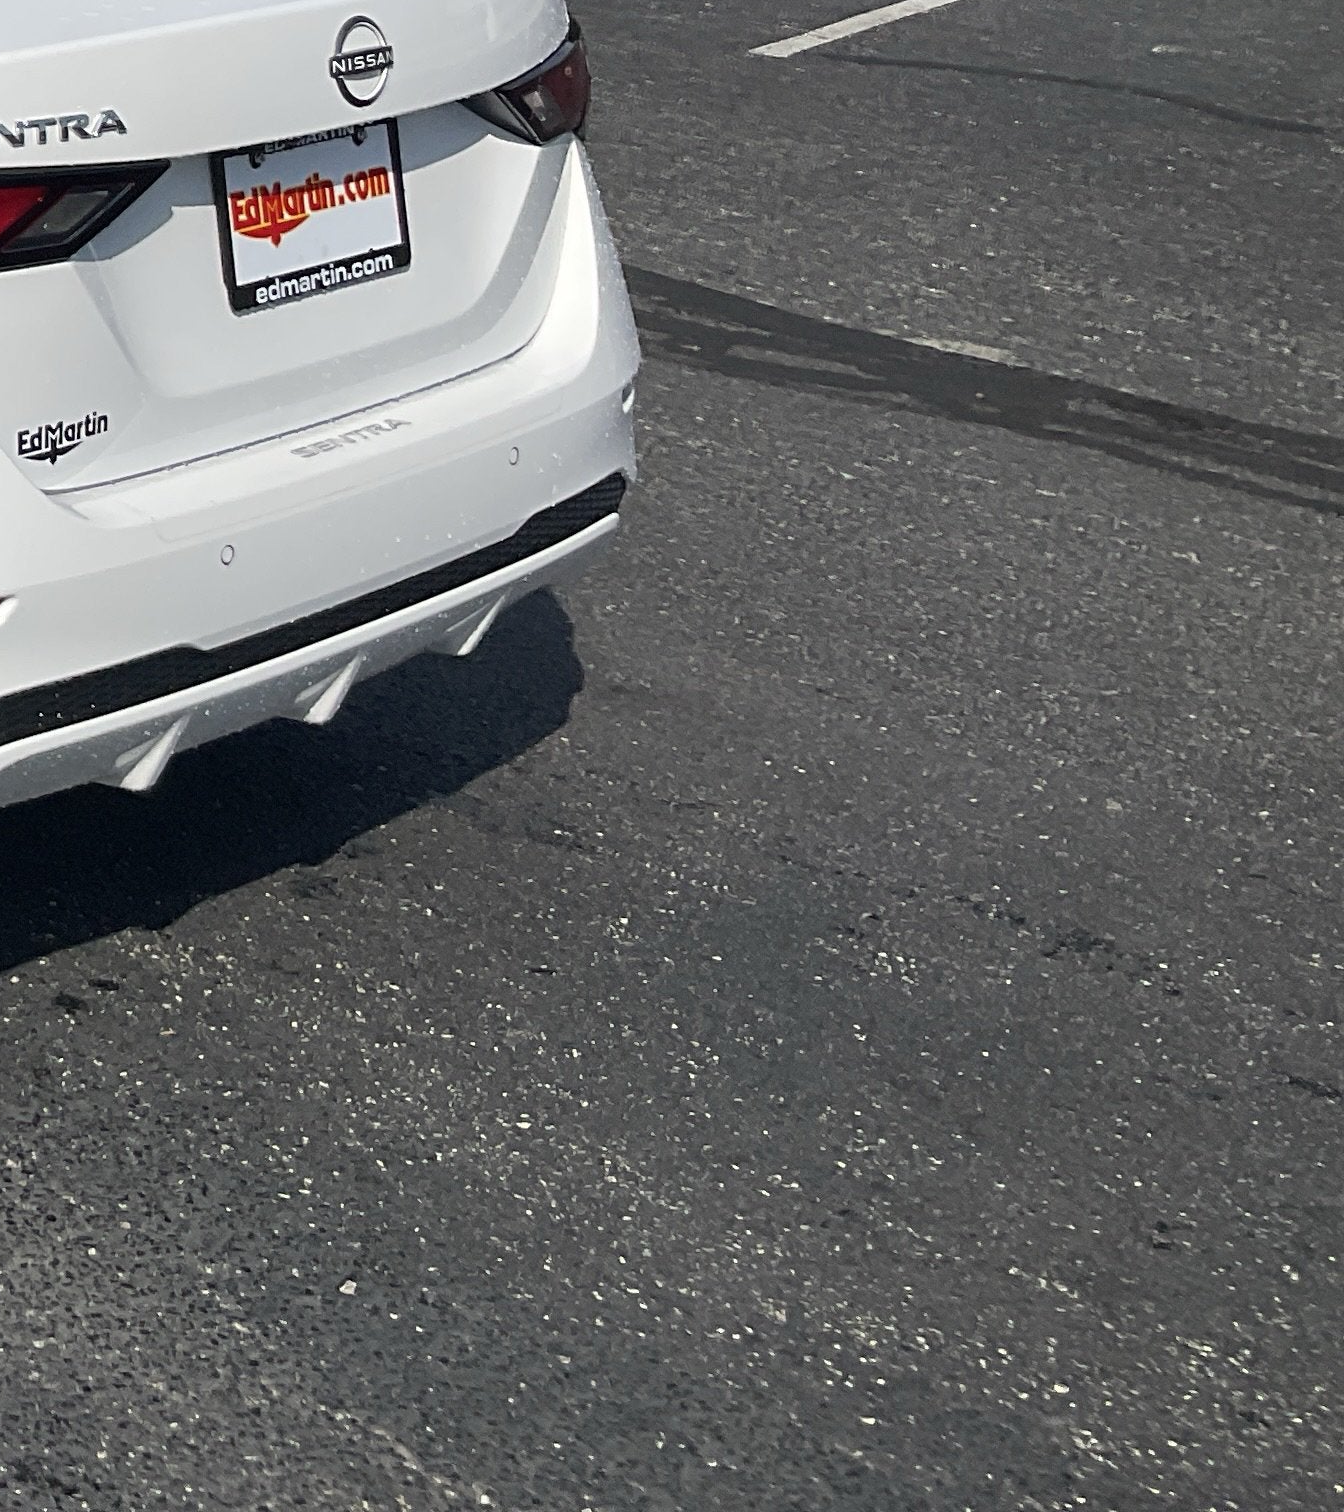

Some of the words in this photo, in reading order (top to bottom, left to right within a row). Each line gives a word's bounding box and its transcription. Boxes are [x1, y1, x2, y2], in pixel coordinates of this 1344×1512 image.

[332, 50, 392, 74] NISSAN
[230, 166, 391, 233] EdMartin.com
[255, 253, 395, 304] edmartin.com
[290, 419, 412, 458] SENTRA
